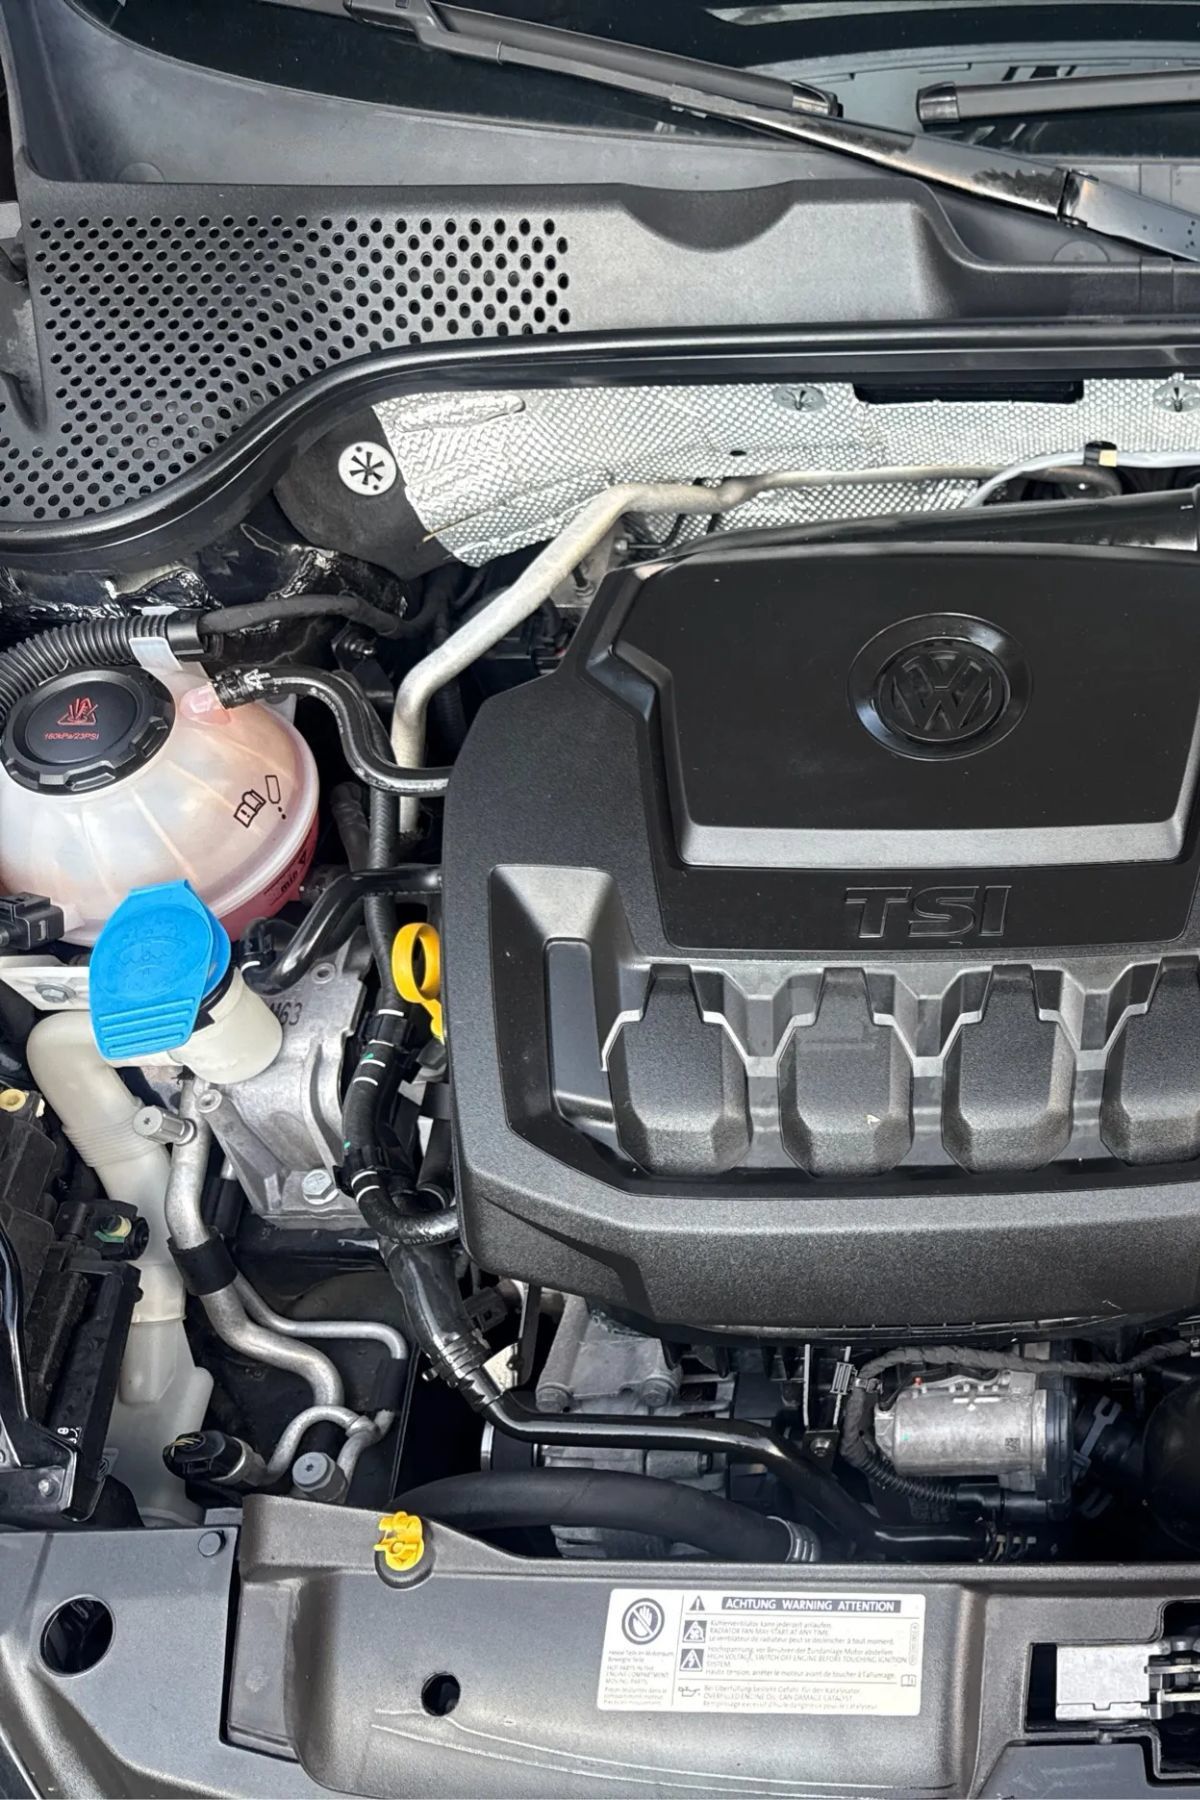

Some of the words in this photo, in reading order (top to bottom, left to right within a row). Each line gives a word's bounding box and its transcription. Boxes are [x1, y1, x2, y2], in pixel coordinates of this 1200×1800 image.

[844, 885, 1012, 938] TSI
[725, 1598, 777, 1610] ACHTUNG
[782, 1600, 833, 1610] WARNING
[837, 1600, 895, 1612] ATTENTION
